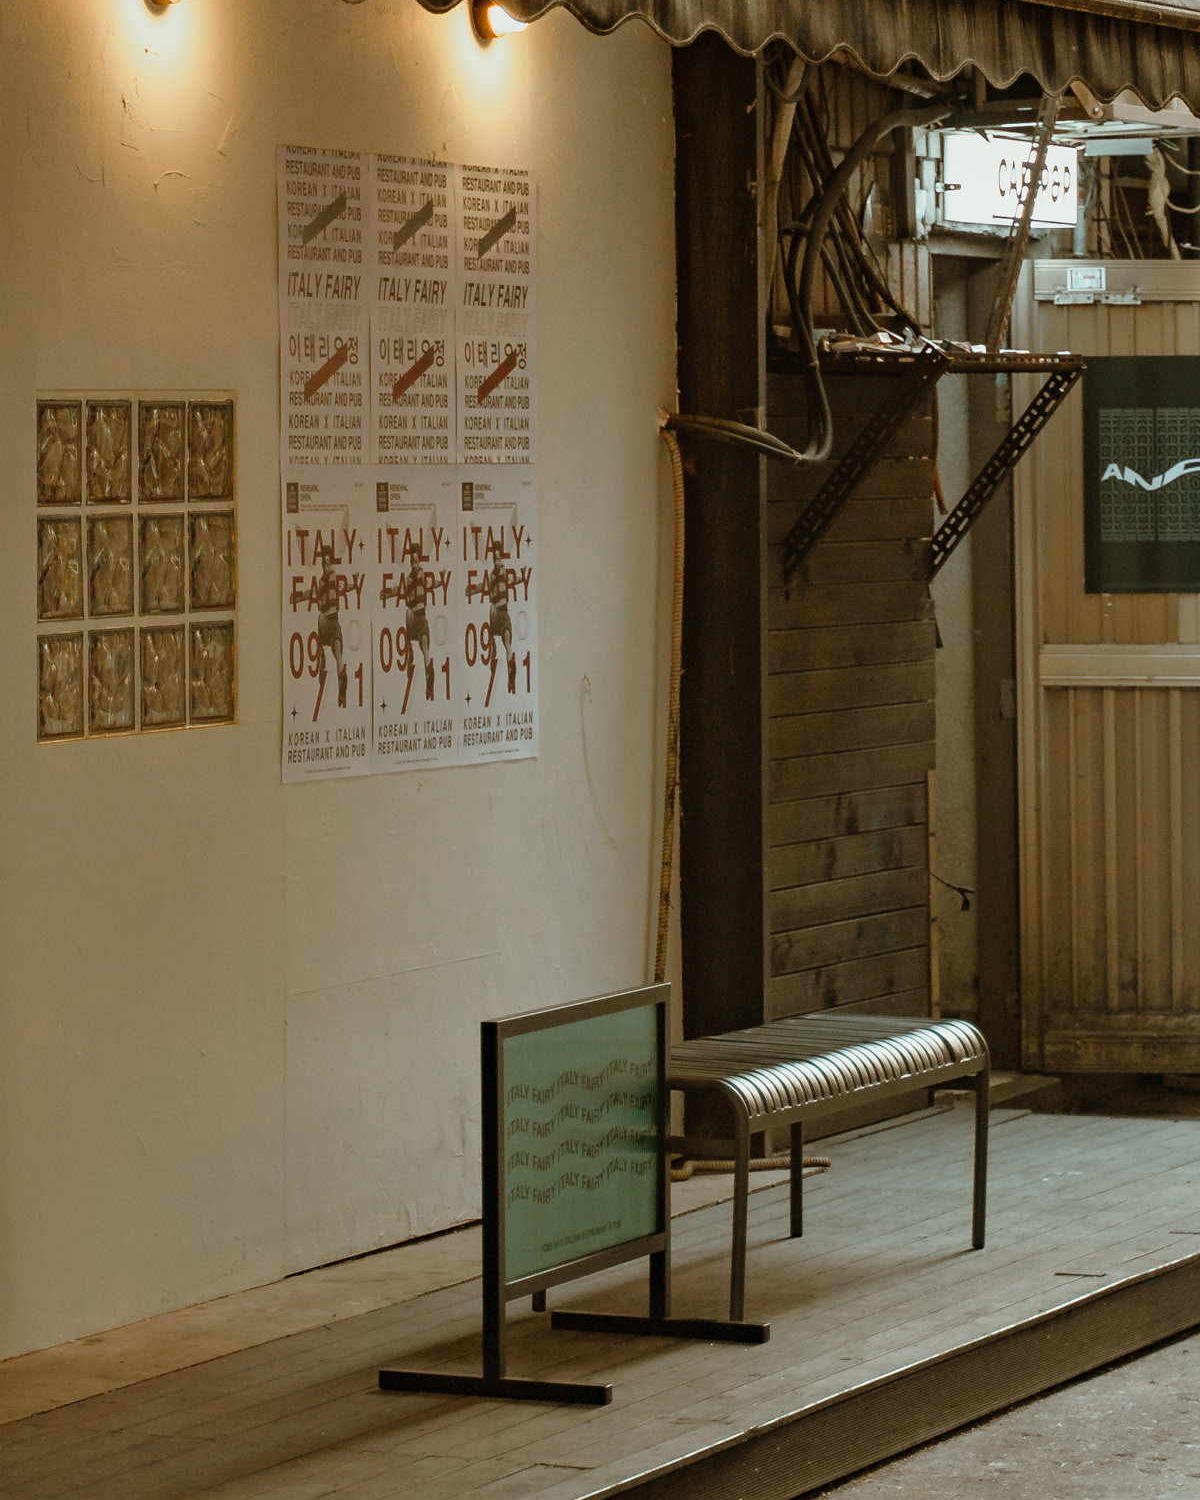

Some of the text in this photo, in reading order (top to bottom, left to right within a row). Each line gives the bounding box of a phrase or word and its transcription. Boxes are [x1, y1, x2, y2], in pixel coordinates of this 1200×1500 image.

[286, 160, 360, 180] RESTAURANT AND PUB
[377, 168, 447, 188] RESTAURANT AND PUB
[286, 181, 317, 197] KOREAN
[322, 184, 327, 197] X
[462, 176, 530, 196] RESTAURANT AND PUB
[377, 188, 406, 204] KOREAN
[411, 191, 415, 205] X
[463, 196, 490, 212] KOREAN
[494, 199, 499, 213] X
[348, 207, 361, 221] PUB
[435, 213, 448, 228] PUB
[332, 228, 362, 243] ITALIAN
[517, 220, 530, 235] PUB
[421, 233, 448, 249] ITALIAN
[504, 241, 530, 255] ITALIAN
[287, 245, 362, 263] RESTAURANT AND PUB
[378, 250, 449, 269] RESTAURANT AND PUB
[464, 257, 530, 275] RESTAURANT AND PUB
[287, 272, 361, 300] ITALY FAIRY
[378, 277, 448, 304] ITALY FAIRY
[463, 282, 529, 309] ITALY FAIRY
[333, 372, 362, 386] ITALIAN
[420, 373, 448, 389] ITALIAN
[504, 376, 530, 390] ITALIAN
[334, 393, 348, 407] AND
[349, 393, 362, 407] PUB
[421, 394, 435, 408] AND
[435, 394, 449, 408] PUB
[504, 395, 517, 410] AND
[518, 396, 530, 410] PUB
[289, 414, 362, 430] KOREAN X ITALIAN
[379, 415, 448, 430] KOREAN X ITALIAN
[464, 417, 530, 431] KOREAN X ITALIAN
[289, 435, 362, 451] RESTAURANT AND PUB
[379, 435, 449, 450] RESTAURANT AND PUB
[464, 436, 530, 450] RESTAURANT AND PUB
[287, 528, 357, 566] ITALY
[377, 527, 444, 564] ITALY
[463, 525, 525, 561] ITALY
[292, 574, 366, 612] FARY
[382, 570, 452, 608] FARY
[467, 567, 533, 605] FARY
[378, 723, 408, 738] KOREAN
[424, 719, 453, 734] ITALIAN
[463, 716, 492, 731] KOREAN
[506, 711, 533, 726] ITALIAN
[288, 731, 320, 747] KOREAN
[336, 726, 366, 742] ITALIAN
[378, 735, 452, 755] RESTAURANT AND PUB
[463, 727, 533, 747] RESTAURANT AND PUB
[288, 743, 366, 764] RESTAURANT AND PUB
[507, 1084, 530, 1107] ITALY
[533, 1082, 555, 1104] FAIRY
[557, 1071, 579, 1093] ITALY
[582, 1067, 604, 1091] FAIRY
[507, 1118, 530, 1140] ITALY
[533, 1115, 555, 1138] FAIRY
[557, 1104, 579, 1126] ITALY
[582, 1101, 604, 1124] FAIRY
[507, 1151, 530, 1174] ITALY
[533, 1148, 555, 1171] FAIRY
[557, 1139, 579, 1160] ITALY
[582, 1136, 604, 1159] FAIRY
[507, 1184, 530, 1208] ITALY
[533, 1182, 556, 1204] FAIRY
[557, 1171, 579, 1194] ITALY
[582, 1168, 605, 1191] FAIRY
